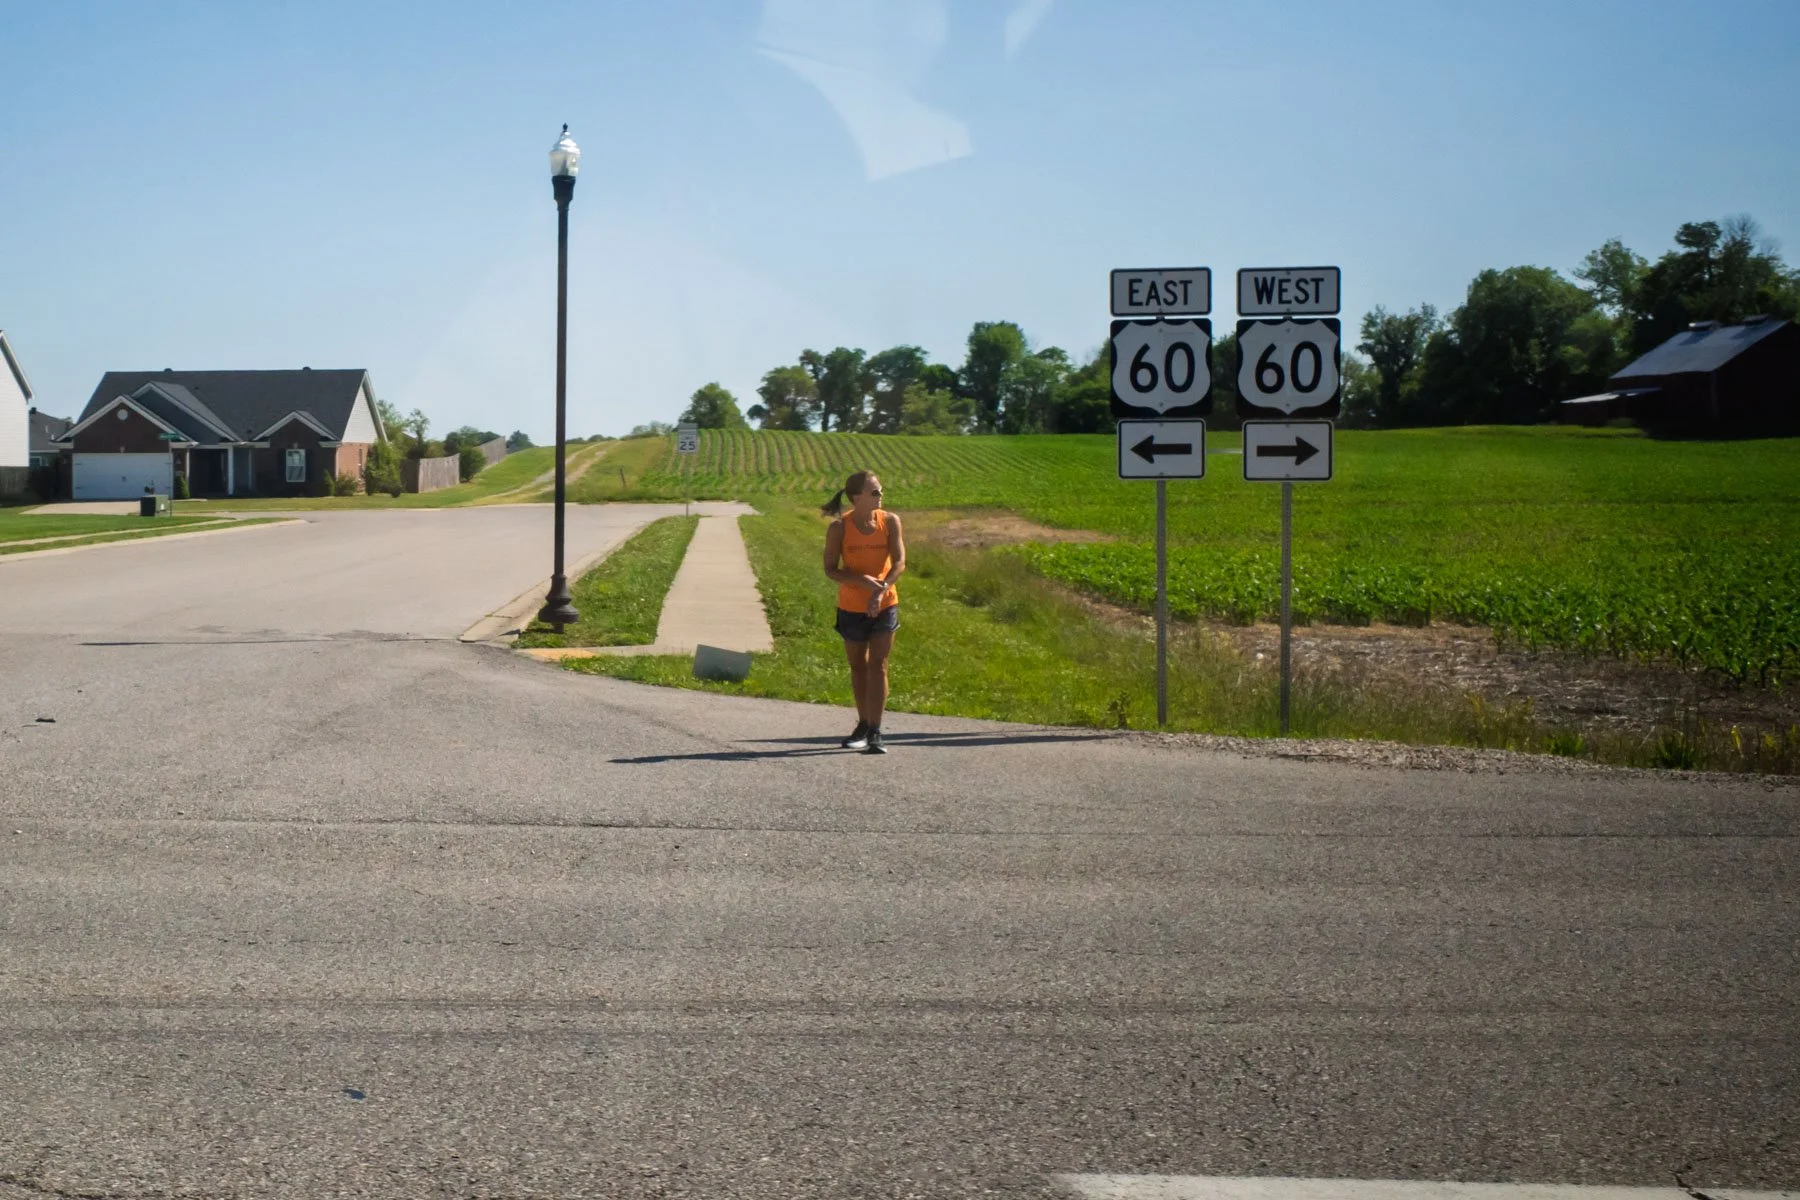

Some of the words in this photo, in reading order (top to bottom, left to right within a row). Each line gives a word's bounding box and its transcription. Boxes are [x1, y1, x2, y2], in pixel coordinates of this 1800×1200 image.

[1128, 278, 1192, 306] EAST
[1254, 276, 1324, 304] WEST
[1129, 341, 1195, 393] 60
[1255, 341, 1322, 394] 60
[680, 441, 696, 451] 25
